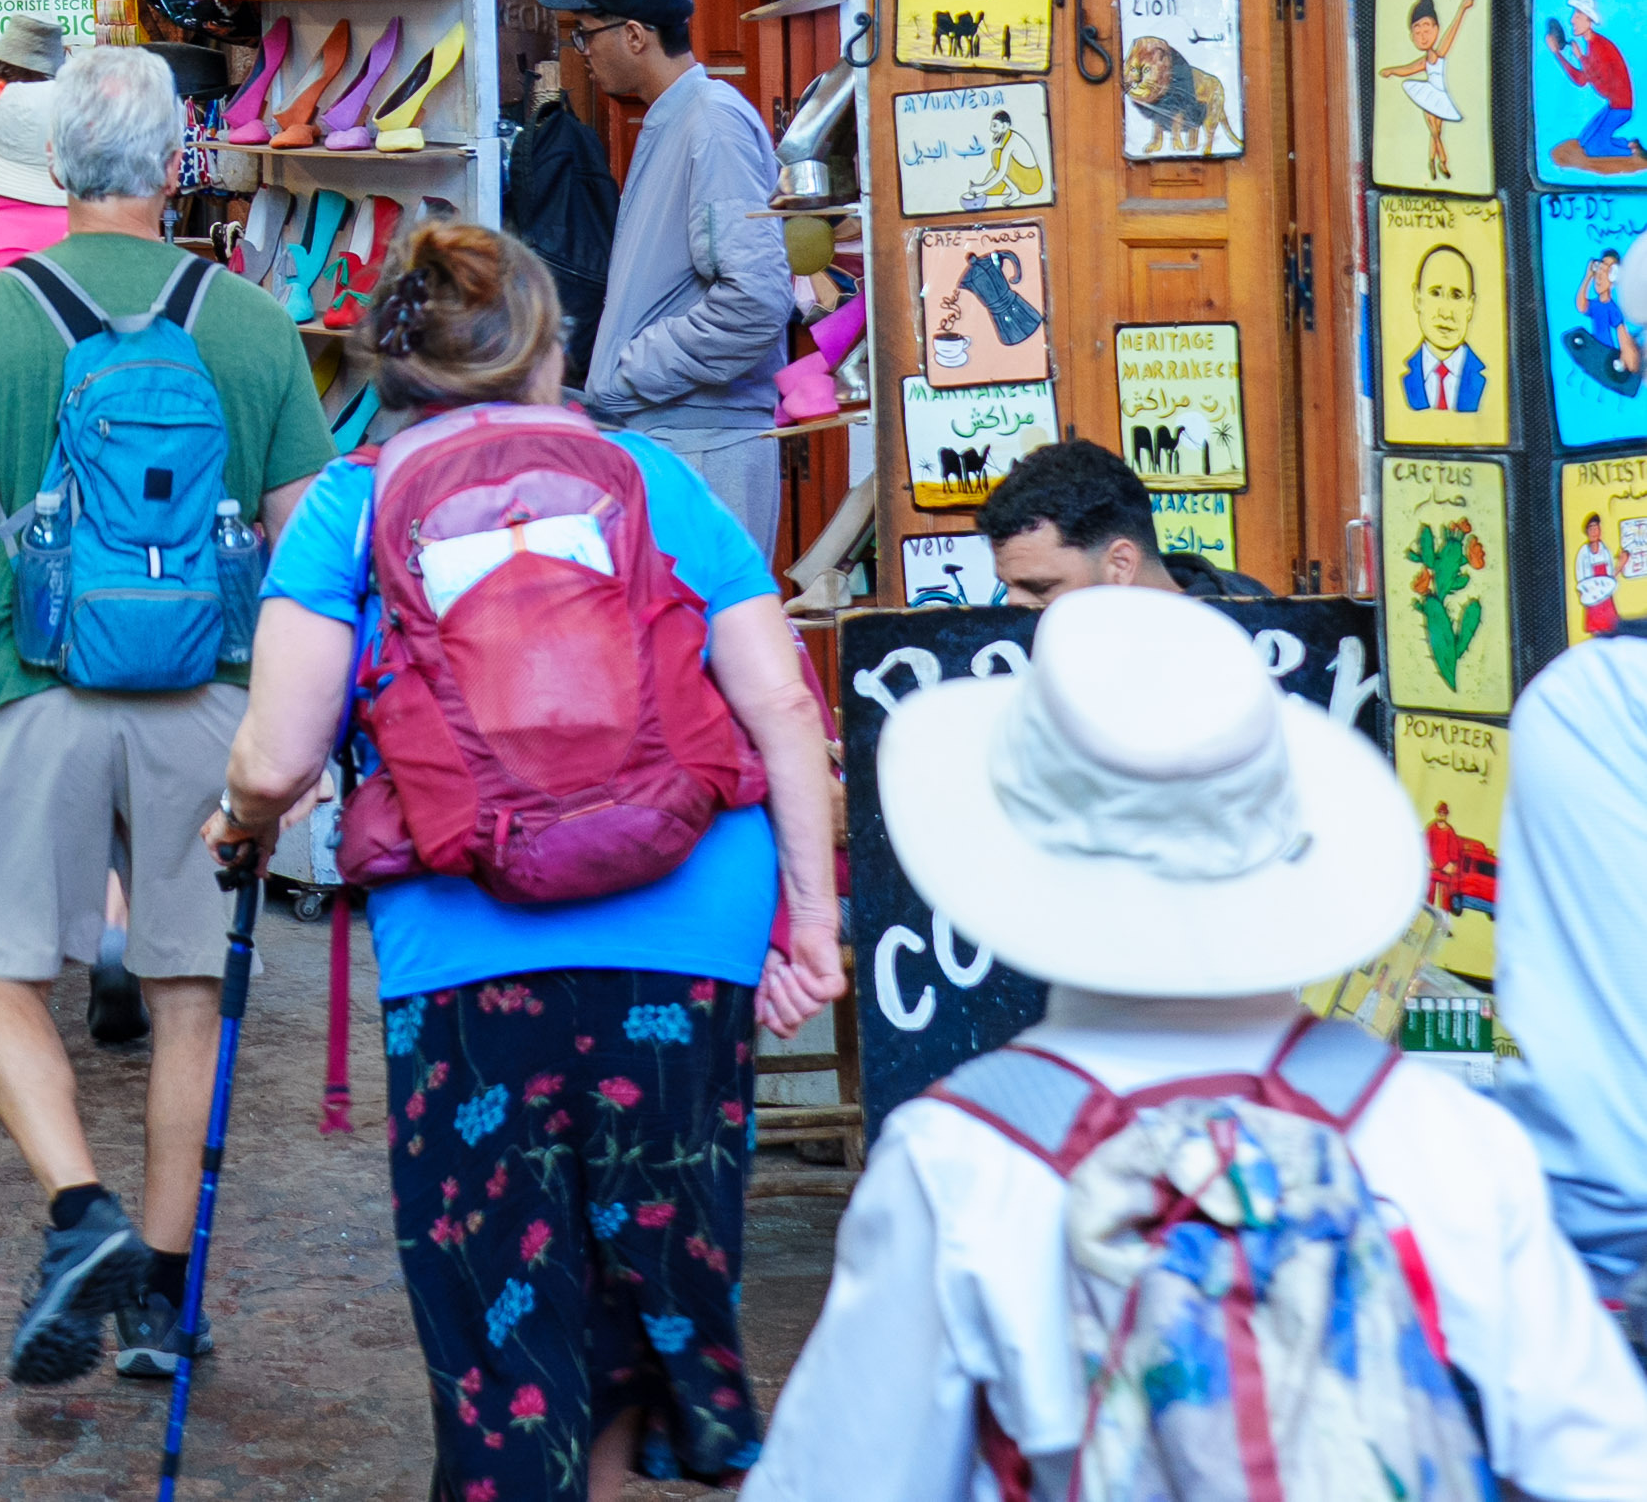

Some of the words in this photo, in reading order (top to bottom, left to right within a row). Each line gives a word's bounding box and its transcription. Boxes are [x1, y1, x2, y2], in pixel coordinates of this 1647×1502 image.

[1120, 331, 1215, 352] HERITAGE
[1121, 359, 1240, 382] MARRAKECH
[1393, 462, 1473, 487] CACTUS
[1576, 459, 1647, 486] ARTIST
[1404, 714, 1498, 754] POMPIER
